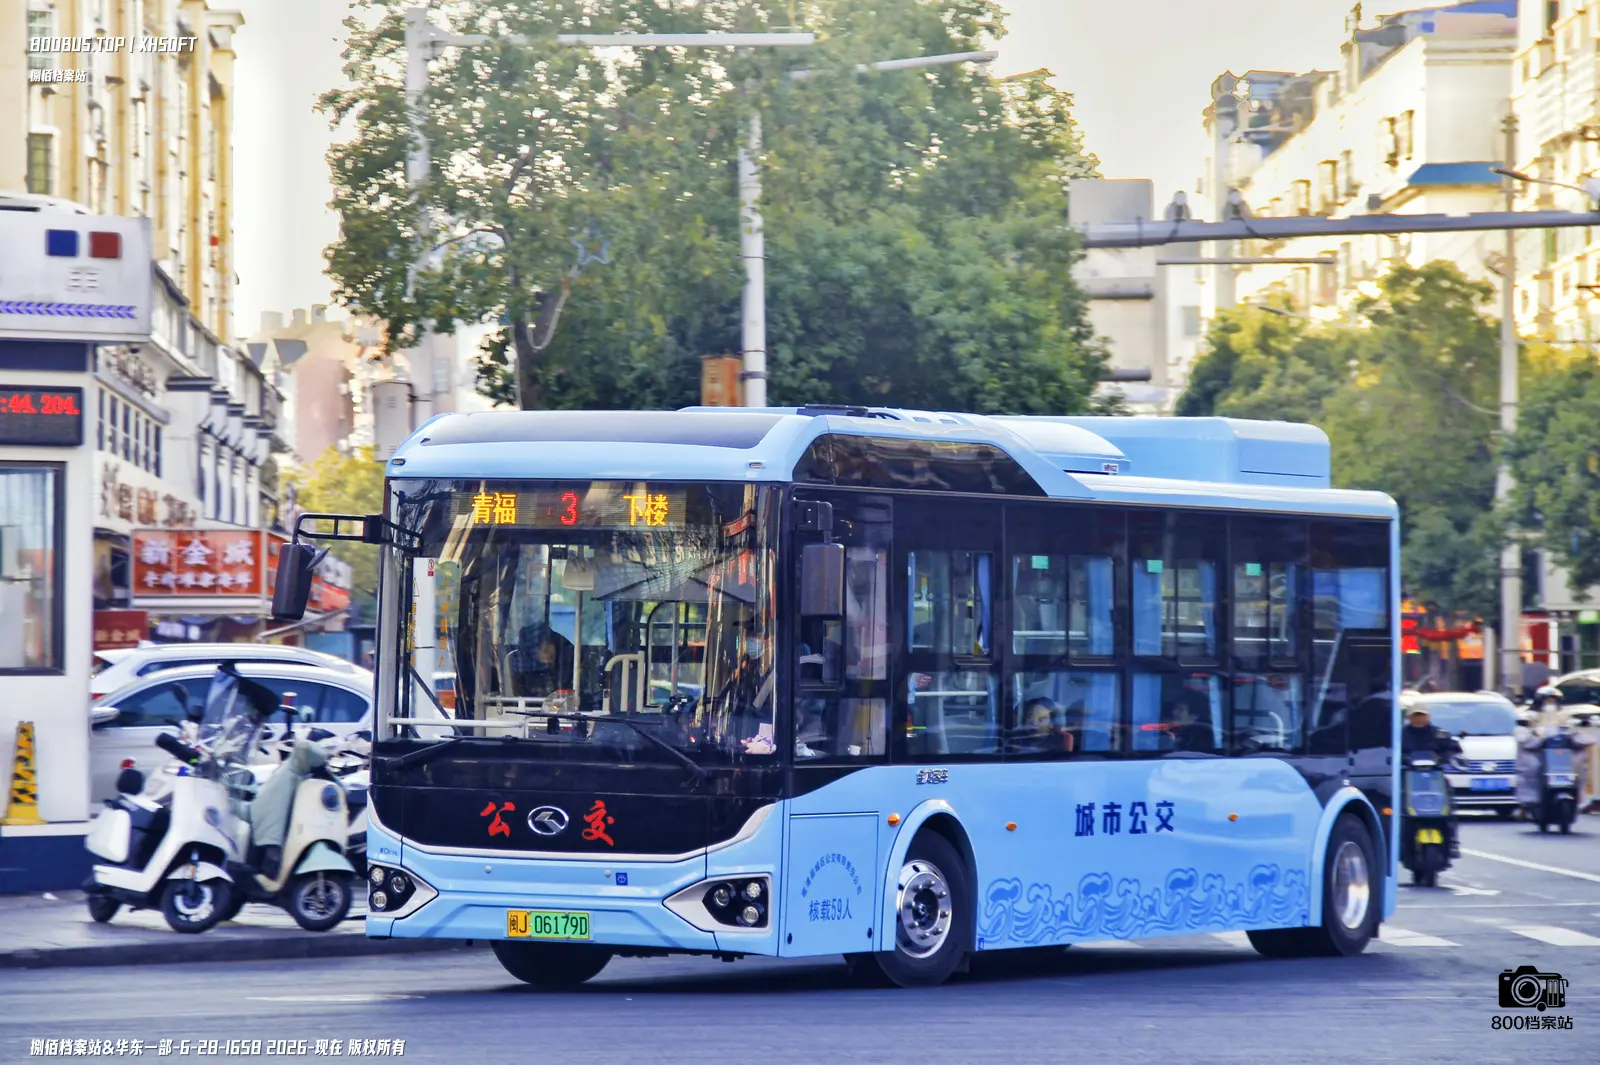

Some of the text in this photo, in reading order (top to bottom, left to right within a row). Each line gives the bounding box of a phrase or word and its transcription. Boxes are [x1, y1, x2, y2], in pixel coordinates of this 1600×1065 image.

[472, 492, 669, 526] 青福 3 下楼
[480, 800, 615, 847] 公 交
[1075, 800, 1175, 837] 城市公交
[534, 915, 588, 935] 06179D
[808, 897, 853, 922] 核载59人
